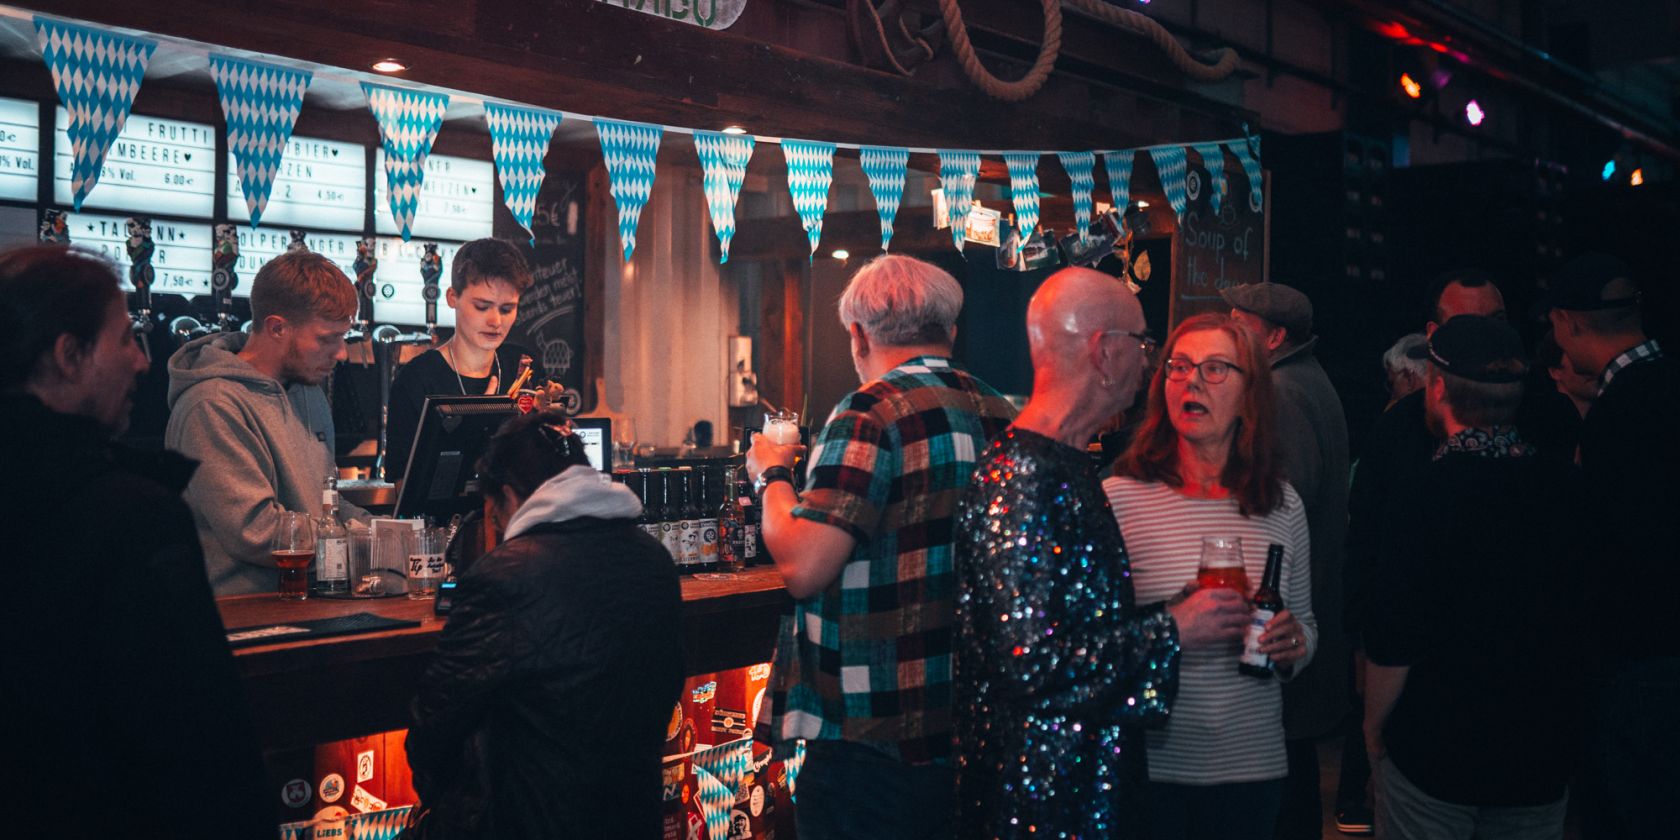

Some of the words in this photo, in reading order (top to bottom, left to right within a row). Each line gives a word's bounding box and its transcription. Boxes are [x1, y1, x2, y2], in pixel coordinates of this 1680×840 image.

[147, 121, 207, 144] FRUTTI
[286, 141, 330, 158] TBIER
[15, 156, 34, 170] Vol.
[100, 220, 175, 241] TALNN
[1185, 211, 1225, 264] Soup
[1233, 227, 1253, 262] of
[240, 231, 345, 254] OLPERNGER
[102, 244, 166, 264] POR
[1187, 256, 1208, 287] the
